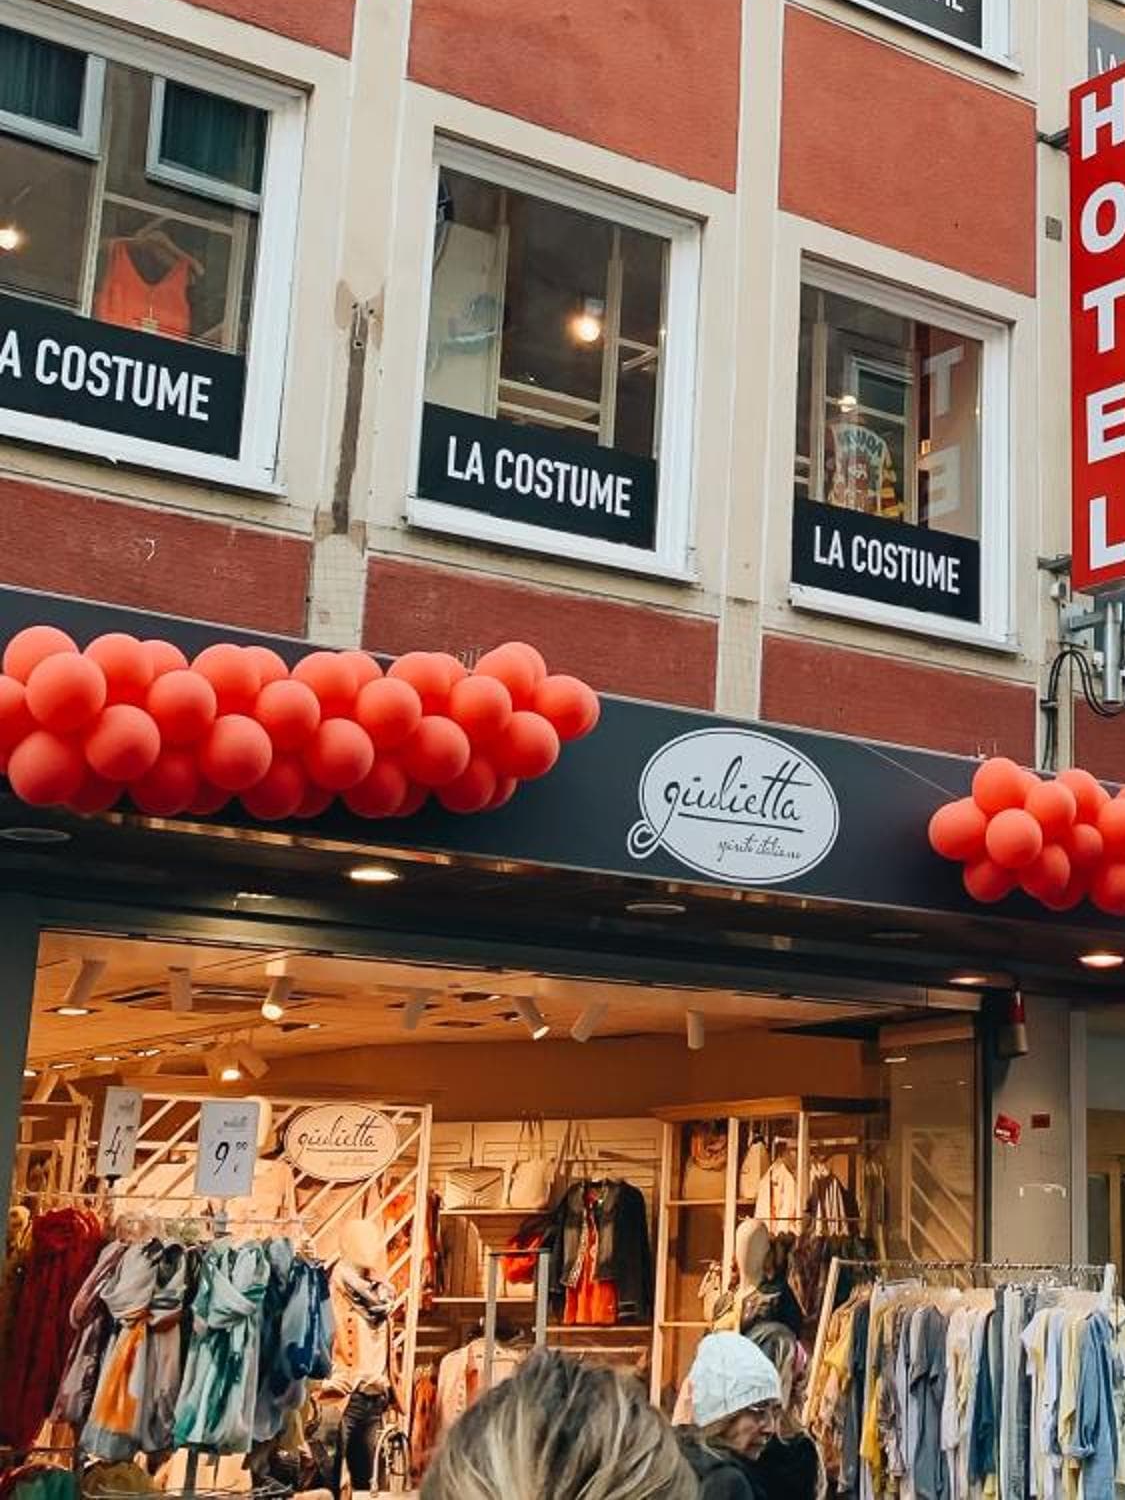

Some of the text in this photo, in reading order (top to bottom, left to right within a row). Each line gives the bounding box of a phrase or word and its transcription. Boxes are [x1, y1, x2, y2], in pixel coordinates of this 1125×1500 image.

[0, 329, 213, 421] A COSTUME
[446, 435, 633, 518] LA COSTUME
[813, 525, 961, 595] LA COSTUME
[655, 755, 813, 838] giulietta
[297, 1115, 383, 1149] giulietta
